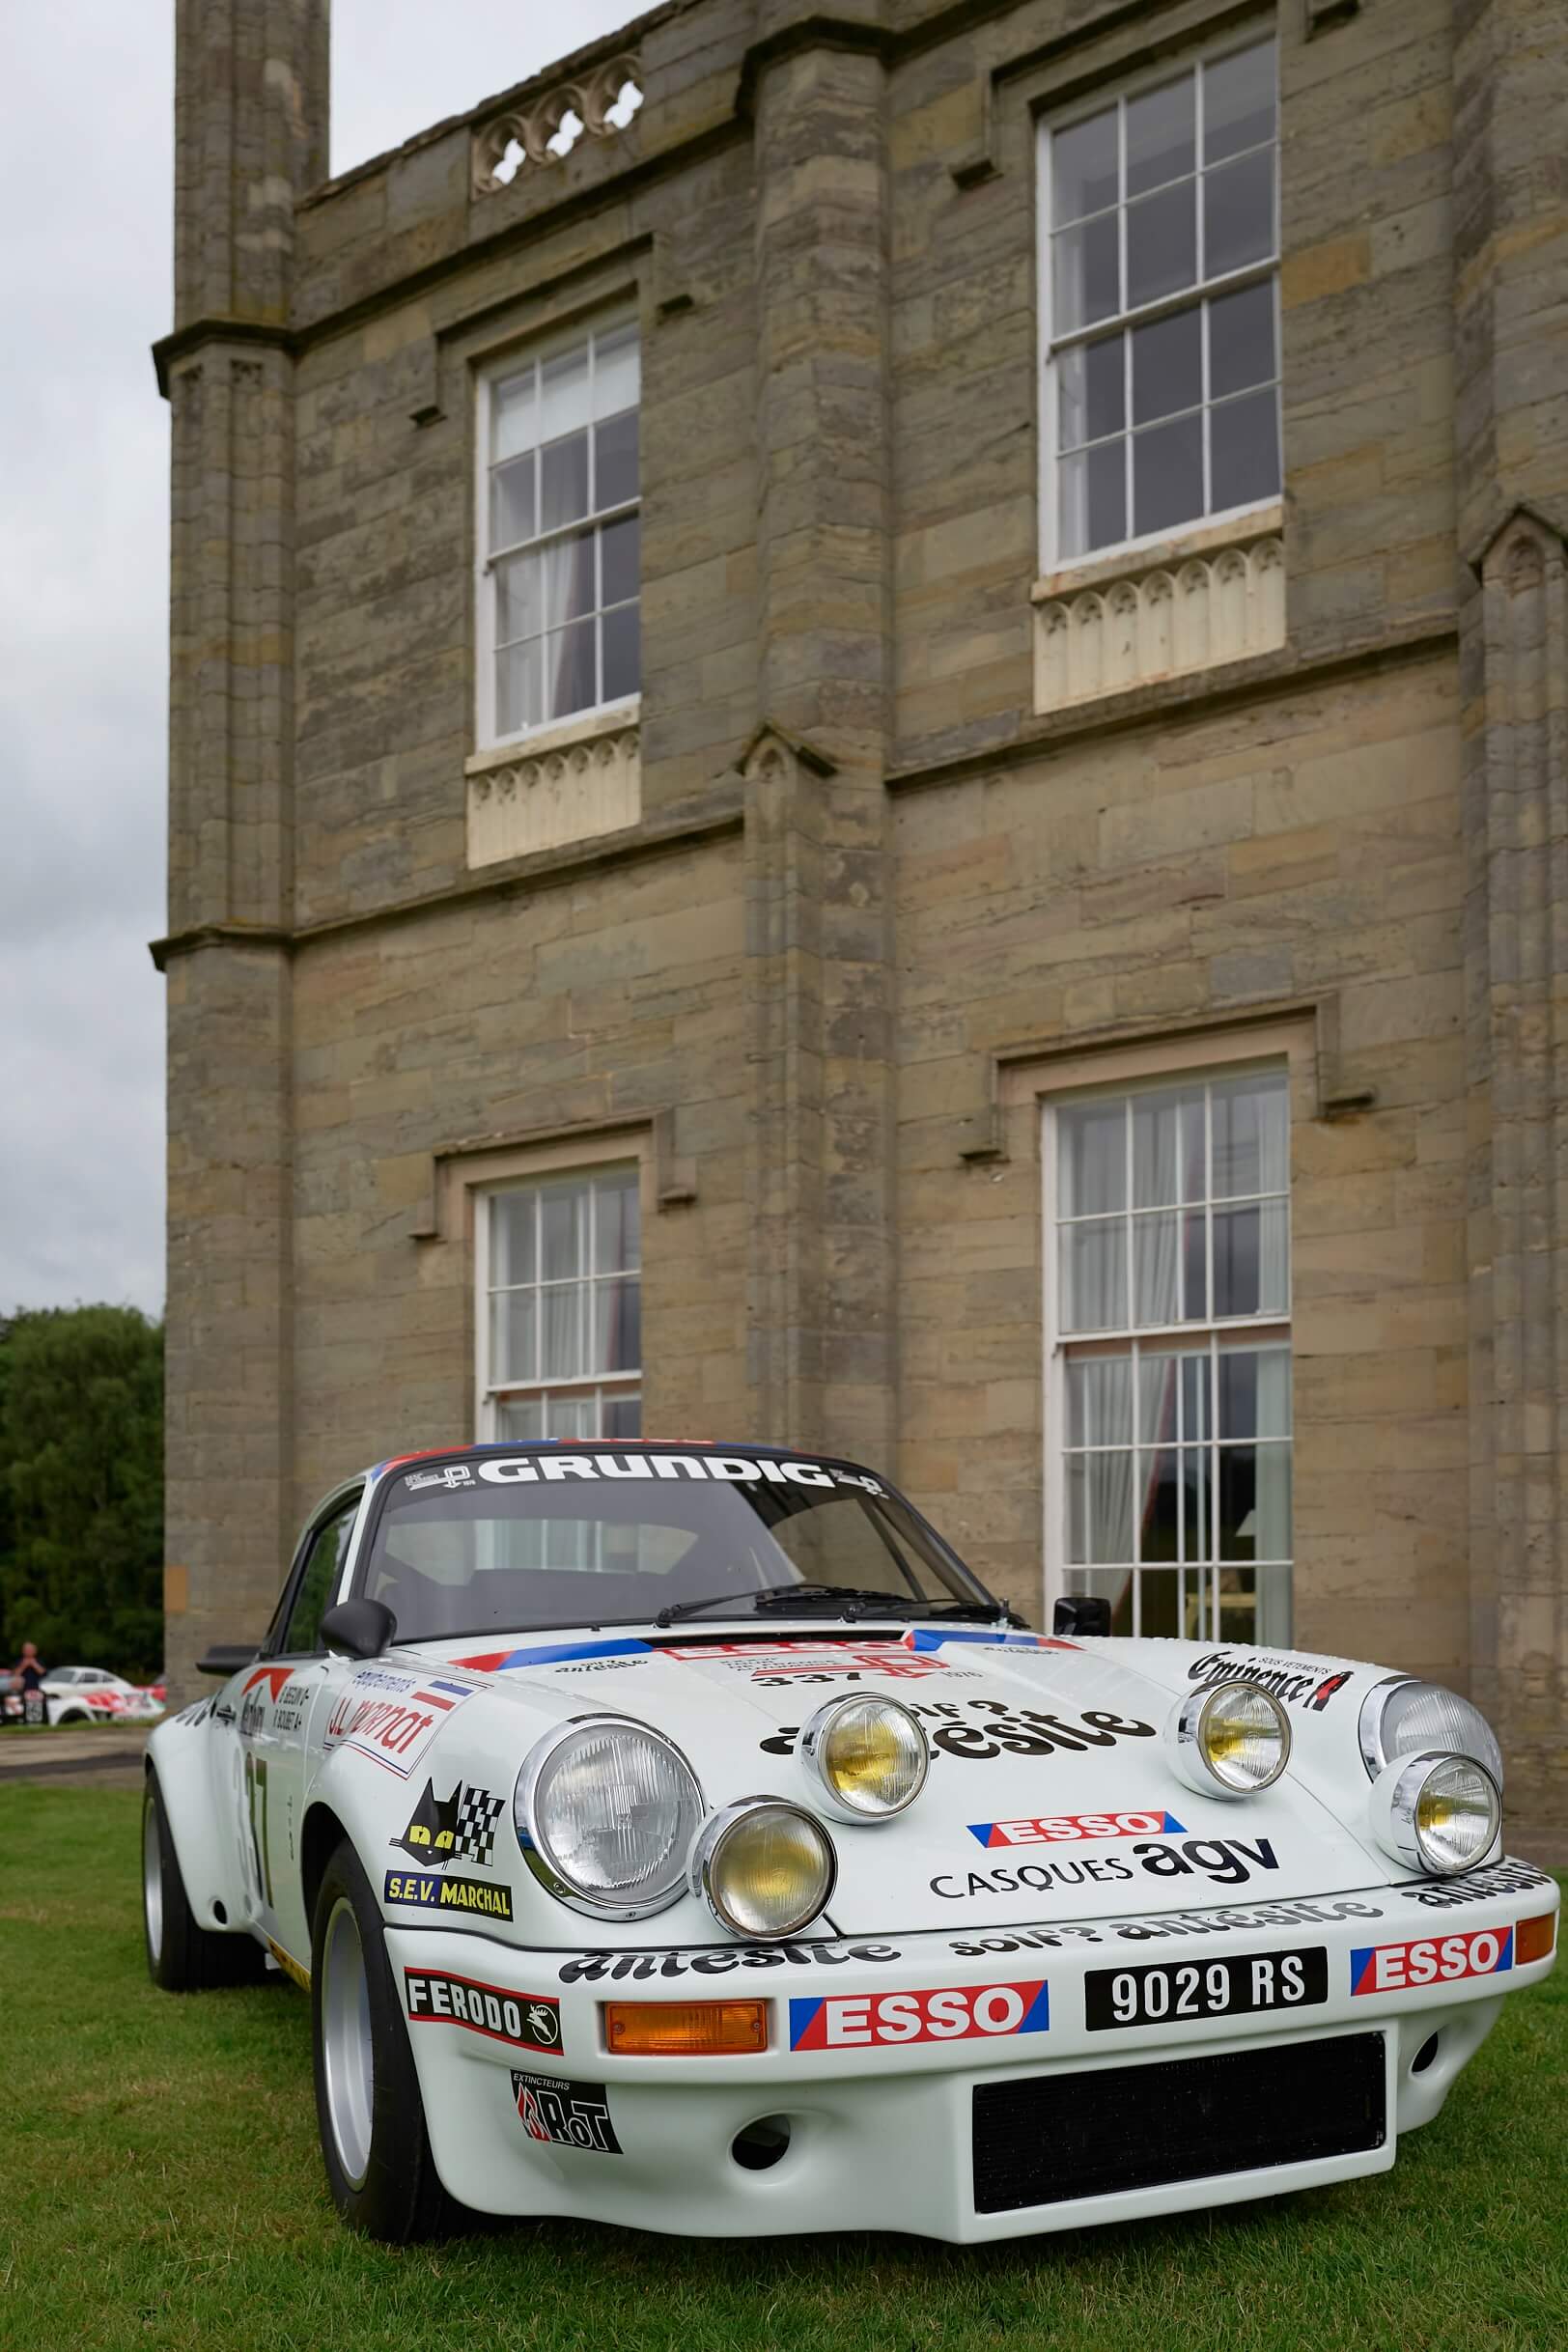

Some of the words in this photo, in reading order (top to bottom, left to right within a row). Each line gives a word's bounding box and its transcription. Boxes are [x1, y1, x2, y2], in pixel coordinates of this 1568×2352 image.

[479, 1454, 835, 1488] GRUNDIG
[667, 1641, 901, 1658] ESSO
[751, 1671, 863, 1687] 337
[759, 1708, 1157, 1760] ésite
[1007, 1812, 1162, 1844] ESSO
[929, 1858, 1134, 1899] CASQUES
[1133, 1837, 1280, 1885] agv
[388, 1876, 436, 1903] S.E.V.
[439, 1880, 511, 1916] MARCHAL
[1374, 1932, 1500, 1990] ESSO
[408, 1978, 522, 2039] FERODO
[1110, 1963, 1231, 2023] 9029
[1251, 1954, 1306, 2006] RS
[826, 1986, 1024, 2046] ESSO
[513, 2072, 571, 2091] EXTINCTEURS
